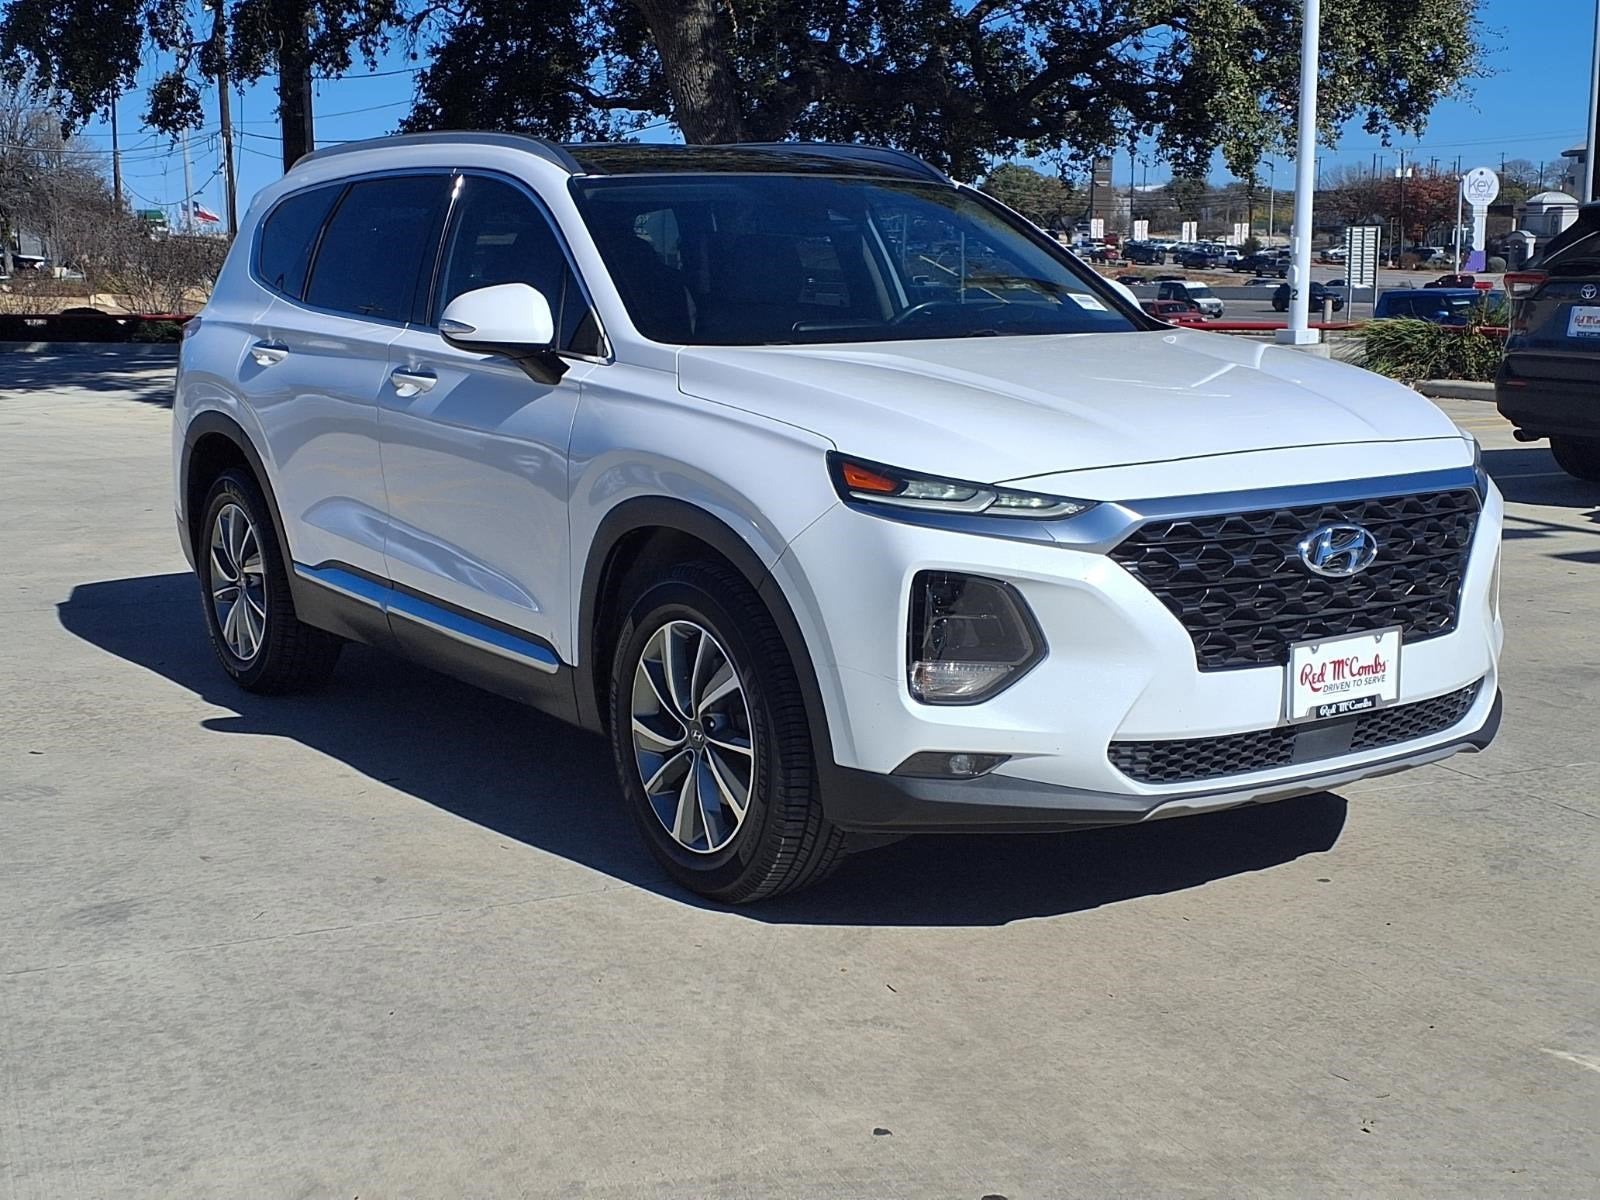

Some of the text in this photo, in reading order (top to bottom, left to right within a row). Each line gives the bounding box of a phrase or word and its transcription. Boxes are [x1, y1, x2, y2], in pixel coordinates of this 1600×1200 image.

[1300, 653, 1386, 692] Red McCombs
[1323, 674, 1386, 693] DRIVEN TO SERVE
[1319, 704, 1337, 717] Red
